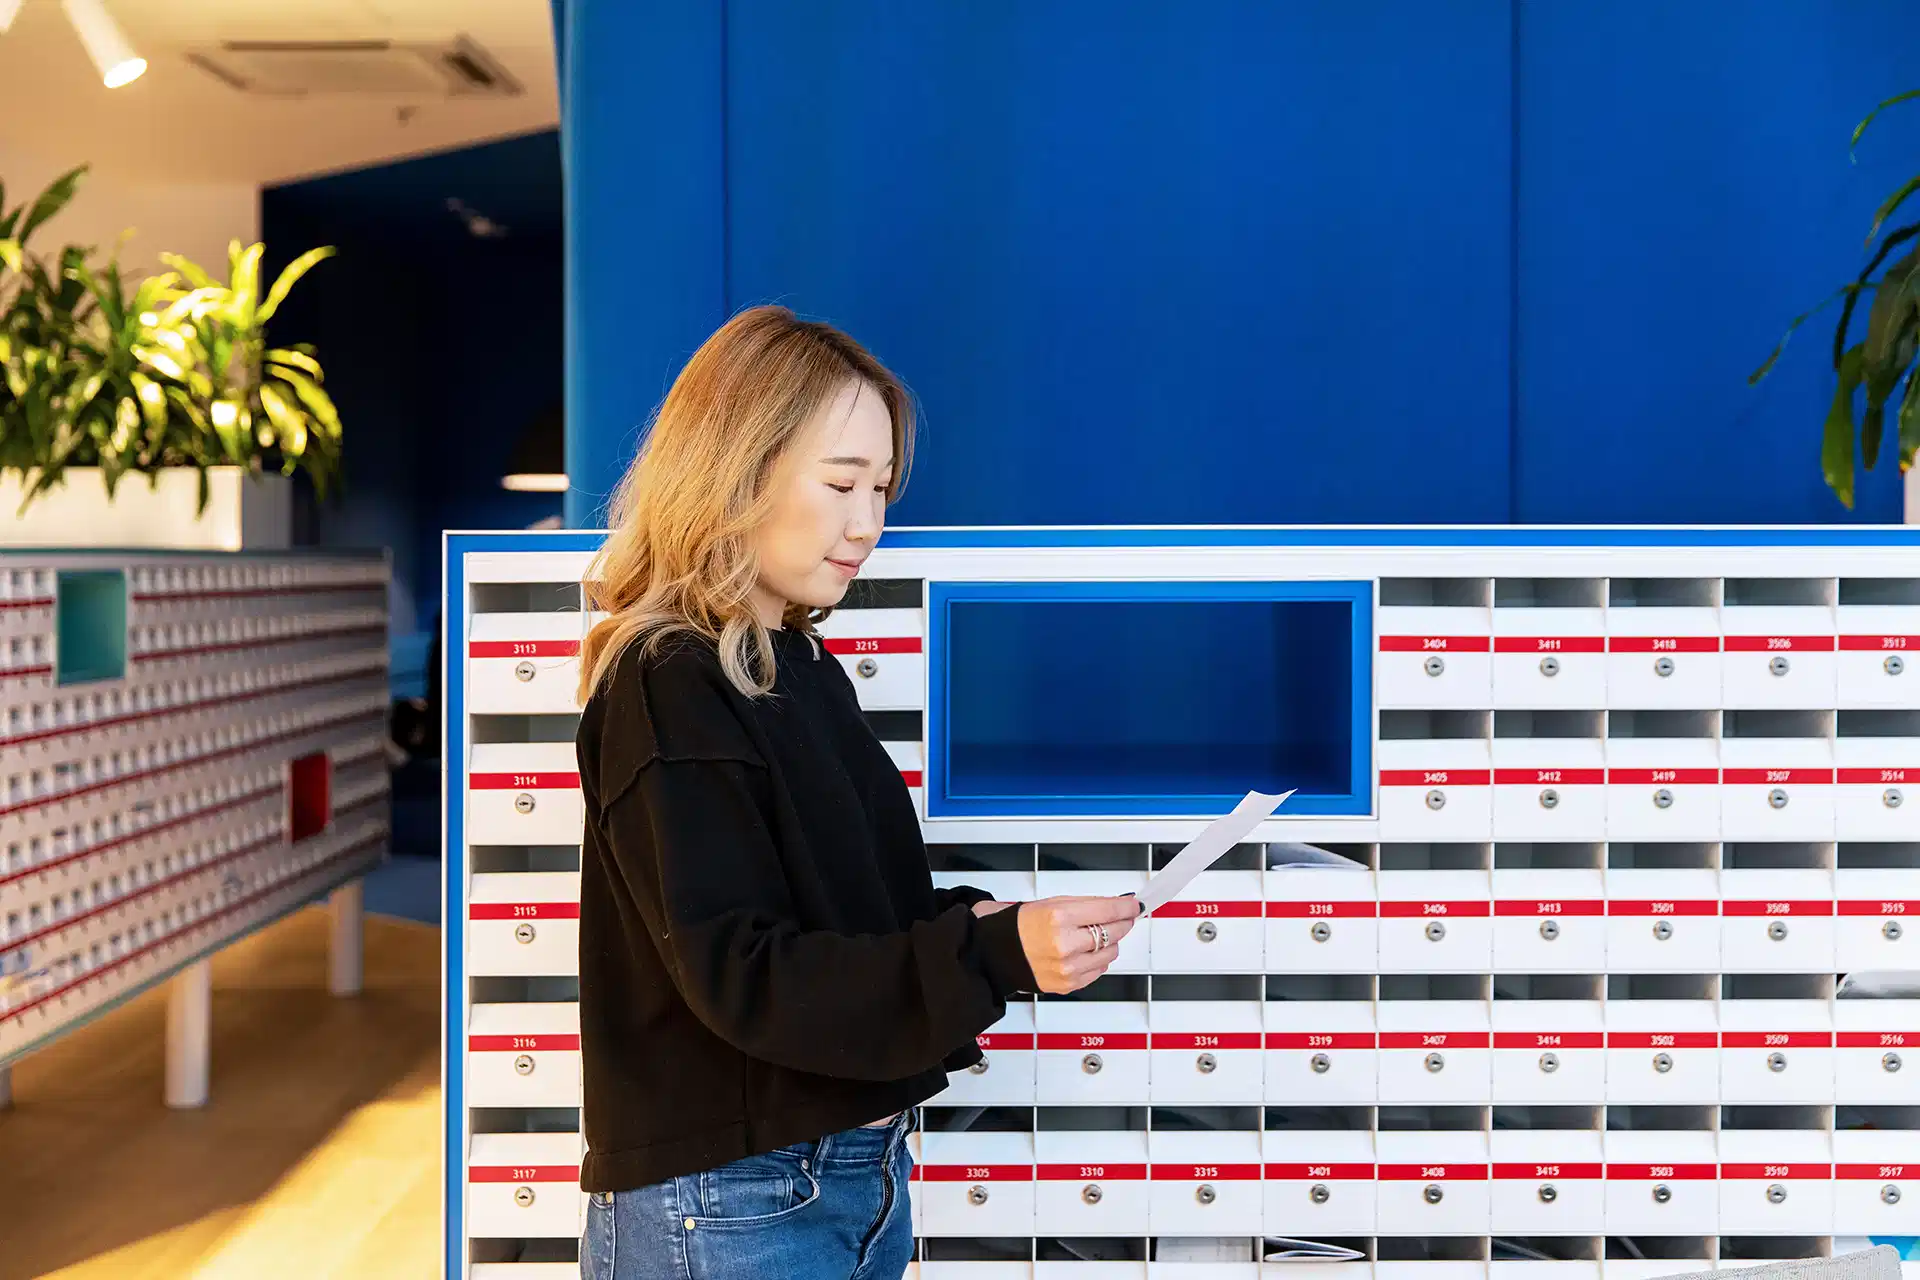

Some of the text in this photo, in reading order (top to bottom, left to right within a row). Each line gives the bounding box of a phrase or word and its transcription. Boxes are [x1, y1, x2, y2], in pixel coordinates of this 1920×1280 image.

[513, 643, 537, 654] 3113
[855, 640, 879, 652] 3215
[1422, 638, 1447, 649] 3404
[1538, 639, 1561, 650] 3411
[1652, 639, 1677, 650] 3418
[1767, 637, 1792, 649] 3506
[1882, 637, 1907, 649] 3513
[513, 775, 537, 786] 3114
[1423, 771, 1448, 783] 3405
[1537, 771, 1562, 782] 3412
[1651, 770, 1676, 782] 3419
[1766, 770, 1791, 782] 3507
[1880, 770, 1905, 782] 3514
[513, 905, 537, 917] 3115
[1195, 904, 1219, 915] 3313
[1309, 904, 1334, 915] 3318
[1423, 903, 1448, 915] 3406
[1537, 902, 1562, 914] 3413
[1651, 902, 1675, 914] 3501
[1766, 902, 1791, 914] 3508
[1881, 902, 1905, 914] 3515
[513, 1037, 537, 1049] 3116
[975, 1036, 991, 1047] 04
[1080, 1036, 1105, 1047] 3309
[1194, 1035, 1219, 1046] 3314
[1308, 1035, 1333, 1046] 3319
[1422, 1034, 1447, 1046] 3407
[1536, 1035, 1561, 1046] 3414
[1650, 1034, 1675, 1046] 3502
[1764, 1034, 1789, 1046] 3509
[1879, 1033, 1905, 1045] 3516
[512, 1168, 537, 1180] 3117
[966, 1167, 990, 1178] 3305
[1080, 1166, 1104, 1177] 3310
[1194, 1166, 1218, 1177] 3315
[1307, 1166, 1331, 1177] 3401
[1421, 1166, 1446, 1177] 3408
[1535, 1165, 1560, 1176] 3415
[1649, 1166, 1674, 1177] 3503
[1763, 1165, 1789, 1177] 3510
[1878, 1166, 1904, 1177] 3517
